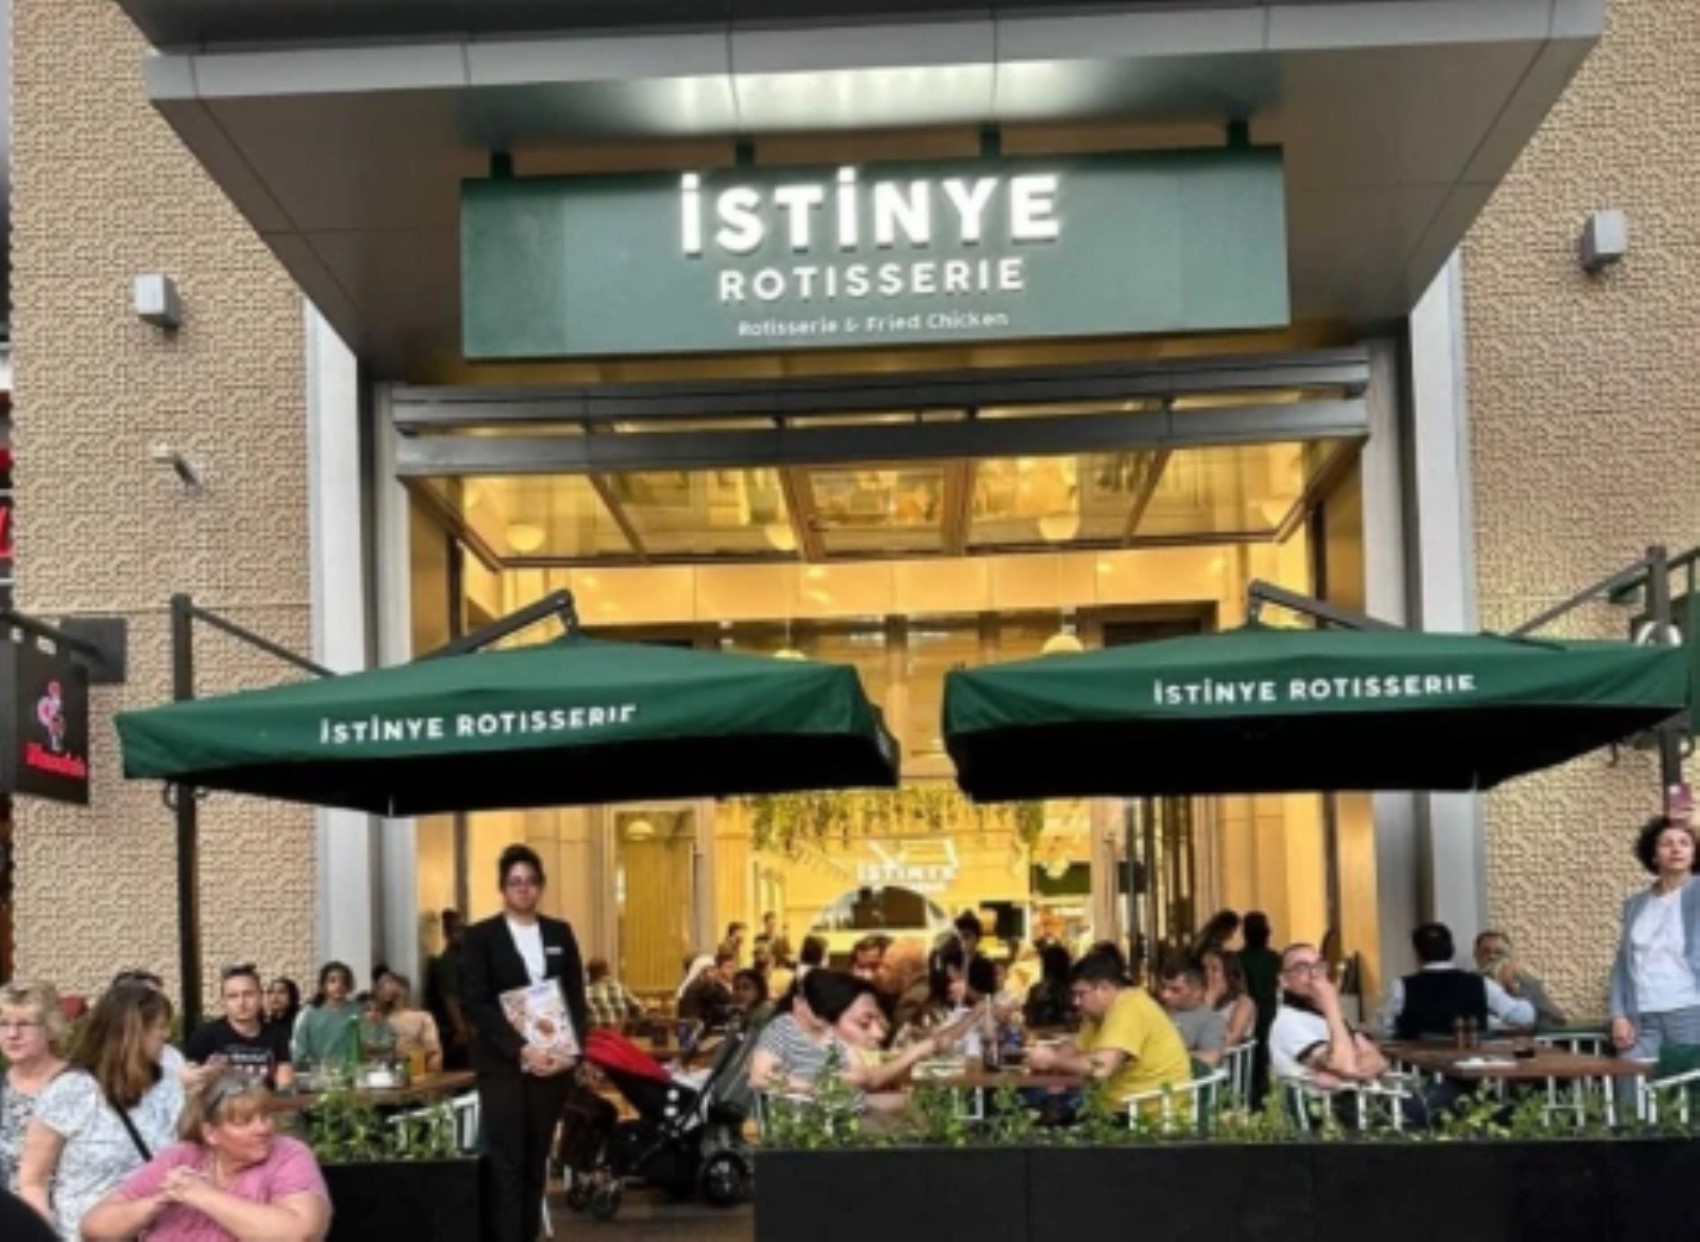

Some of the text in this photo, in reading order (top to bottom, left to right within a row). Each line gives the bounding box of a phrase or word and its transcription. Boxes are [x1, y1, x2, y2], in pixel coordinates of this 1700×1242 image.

[681, 166, 1059, 254] İSTİNYE
[719, 258, 1024, 302] ROTISSERIE
[738, 310, 1009, 337] Rotisserie & Fried Chicken
[1153, 674, 1477, 705] İSTİNYE ROTISSERIE
[320, 713, 444, 744] İSTİNYE
